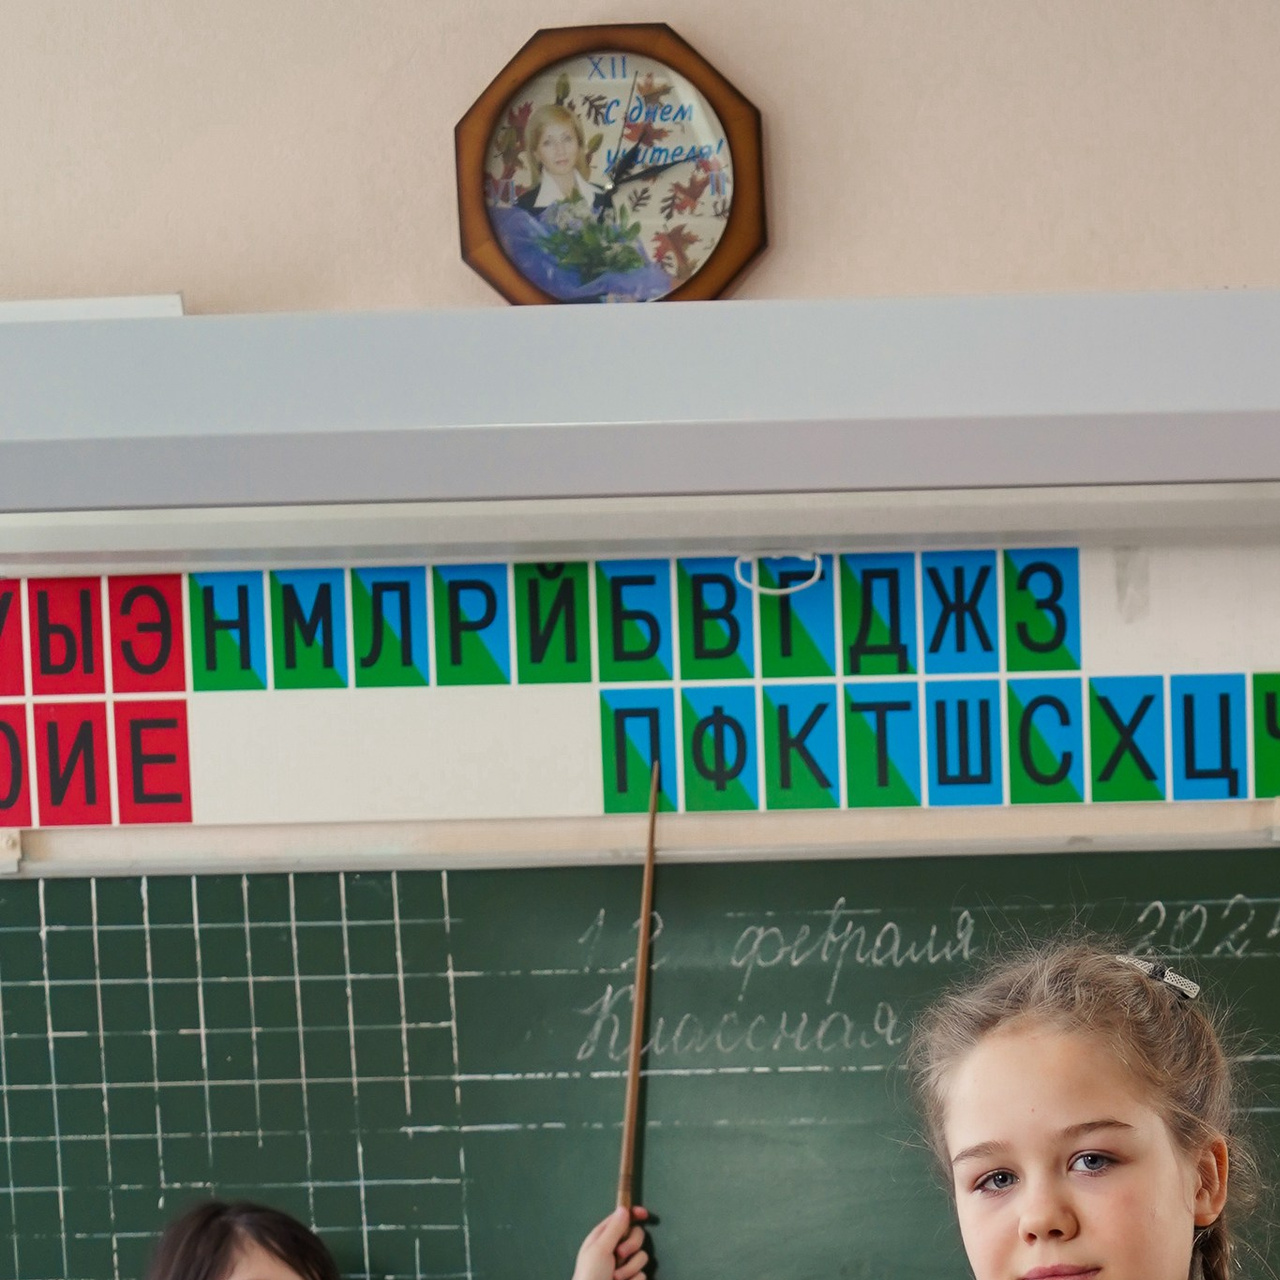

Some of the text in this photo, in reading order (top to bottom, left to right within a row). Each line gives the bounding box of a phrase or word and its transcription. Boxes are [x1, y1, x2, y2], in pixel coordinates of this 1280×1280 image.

[588, 55, 627, 80] XII
[629, 96, 693, 123] днем
[37, 589, 94, 675] Ы
[120, 585, 172, 675] Э
[201, 585, 252, 671] Н
[282, 583, 335, 670] М
[359, 581, 413, 669] Л
[446, 580, 497, 667] Р
[527, 562, 578, 664] Й
[609, 575, 661, 662] Б
[693, 573, 741, 660] В
[778, 570, 826, 658] Г
[849, 568, 909, 675] Д
[927, 565, 993, 653] Ж
[1014, 561, 1067, 654] З
[47, 720, 97, 806] И
[130, 719, 183, 805] Е
[614, 708, 661, 793] П
[691, 706, 748, 792] Ф
[777, 703, 832, 790] К
[849, 701, 912, 788] Т
[935, 699, 991, 785] Ш
[1018, 695, 1073, 786] С
[1096, 695, 1158, 783] Х
[1183, 693, 1239, 797] Ц
[730, 896, 980, 1005] февраля
